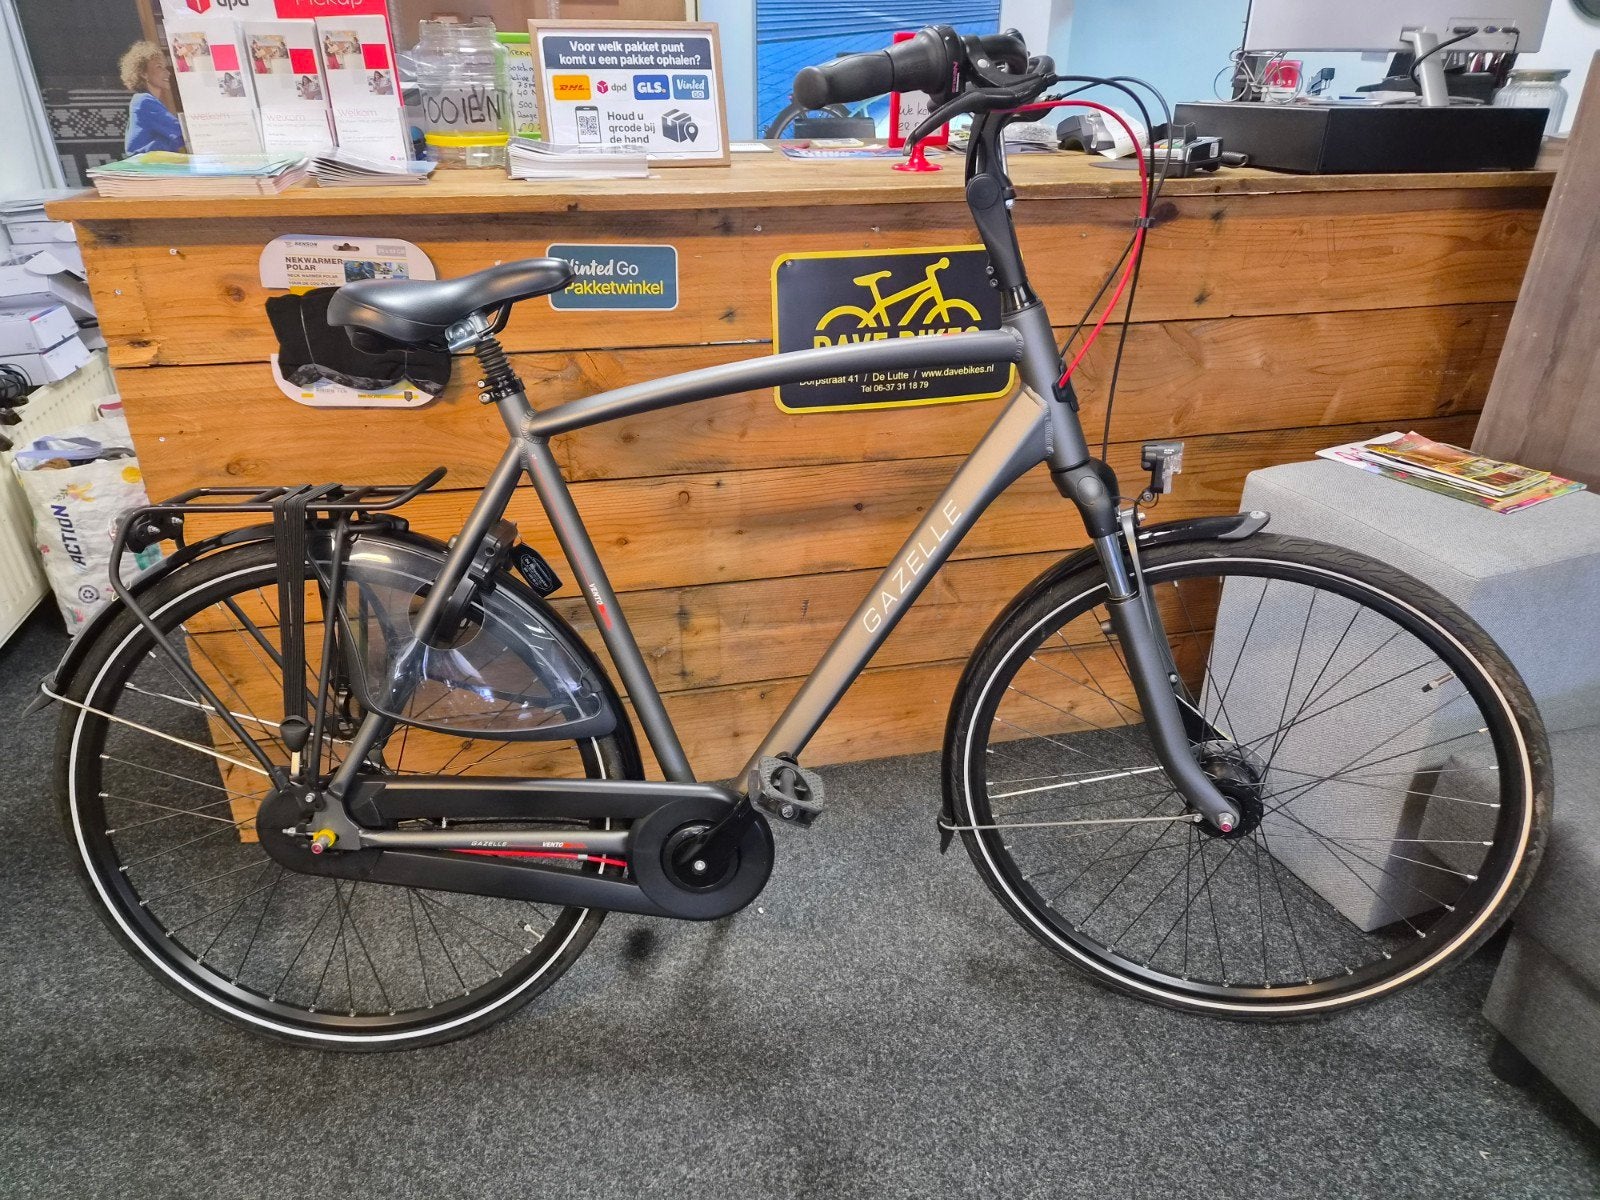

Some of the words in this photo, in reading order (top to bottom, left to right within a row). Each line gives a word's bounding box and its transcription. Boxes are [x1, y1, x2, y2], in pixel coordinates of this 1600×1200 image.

[569, 41, 595, 52] Voor
[597, 41, 622, 52] welk
[625, 41, 659, 55] pakket
[661, 42, 684, 54] punt
[559, 54, 586, 65] komt
[590, 56, 596, 65] u
[598, 56, 618, 65] een
[620, 54, 655, 67] pakket
[656, 54, 701, 67] ophalen?
[611, 83, 627, 93] dpd
[676, 78, 705, 90] Vinted
[607, 111, 635, 121] Houd
[637, 113, 644, 121] u
[608, 123, 642, 133] qrcode
[644, 123, 656, 133] bij
[609, 136, 622, 144] de
[623, 135, 650, 144] hand
[285, 256, 343, 265] NEKWARMER
[616, 261, 639, 276] Go
[847, 374, 859, 383] 41
[872, 372, 886, 382] De
[887, 370, 909, 381] Lutte
[921, 364, 995, 378] www.davebikes.nl
[861, 384, 872, 393] Tel
[873, 383, 895, 392] 06-37
[897, 382, 907, 391] 31
[909, 382, 918, 390] 18
[920, 381, 929, 389] 79
[50, 504, 87, 567] ACTION
[862, 499, 962, 634] GAZELLE
[589, 582, 604, 605] VENTO
